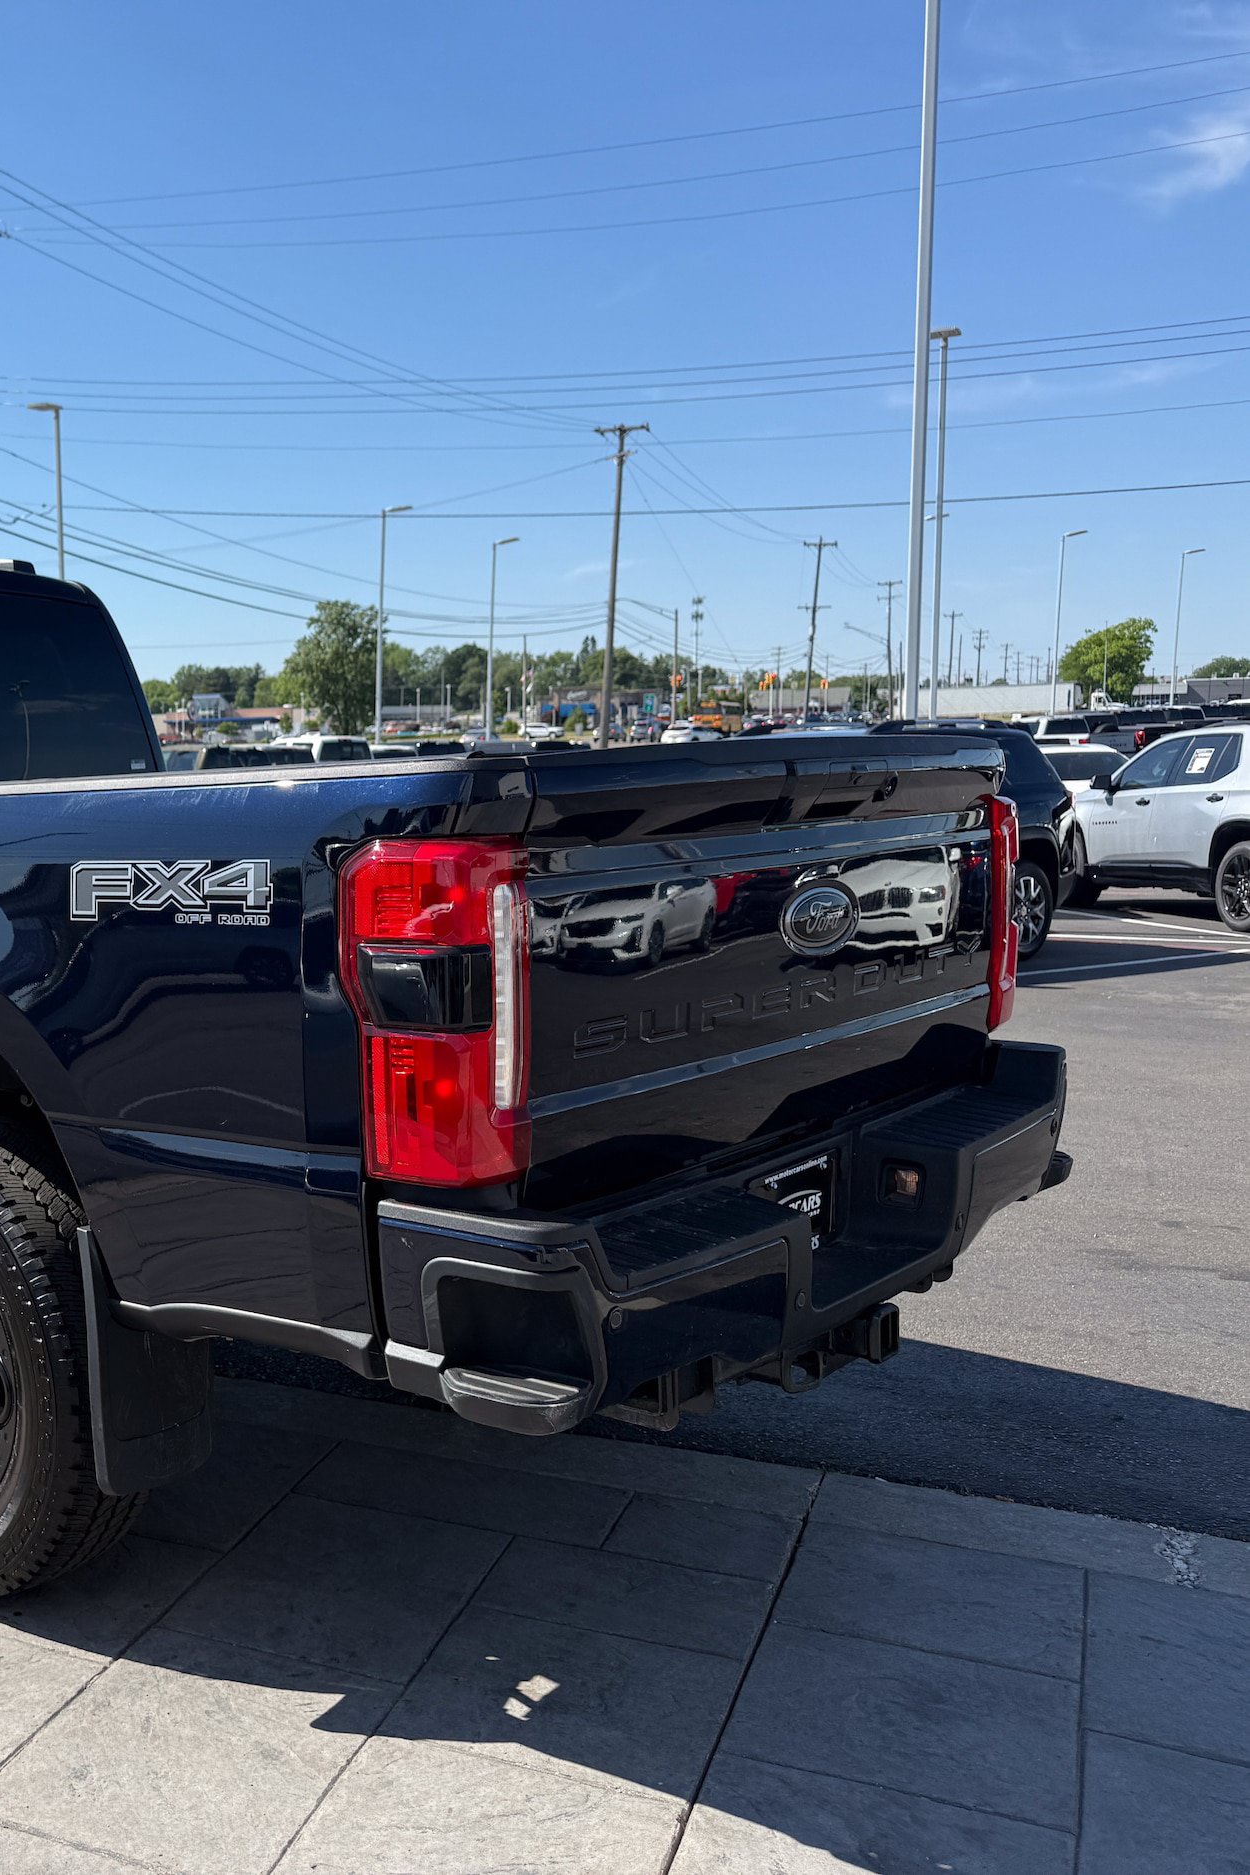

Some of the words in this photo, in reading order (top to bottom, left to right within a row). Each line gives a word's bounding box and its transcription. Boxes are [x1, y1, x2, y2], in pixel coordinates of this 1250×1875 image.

[70, 859, 273, 921] FX4
[175, 913, 212, 925] OFF
[218, 914, 270, 926] ROAD
[806, 899, 847, 934] Ford
[573, 975, 837, 1059] SUPER
[852, 934, 981, 995] DUTY
